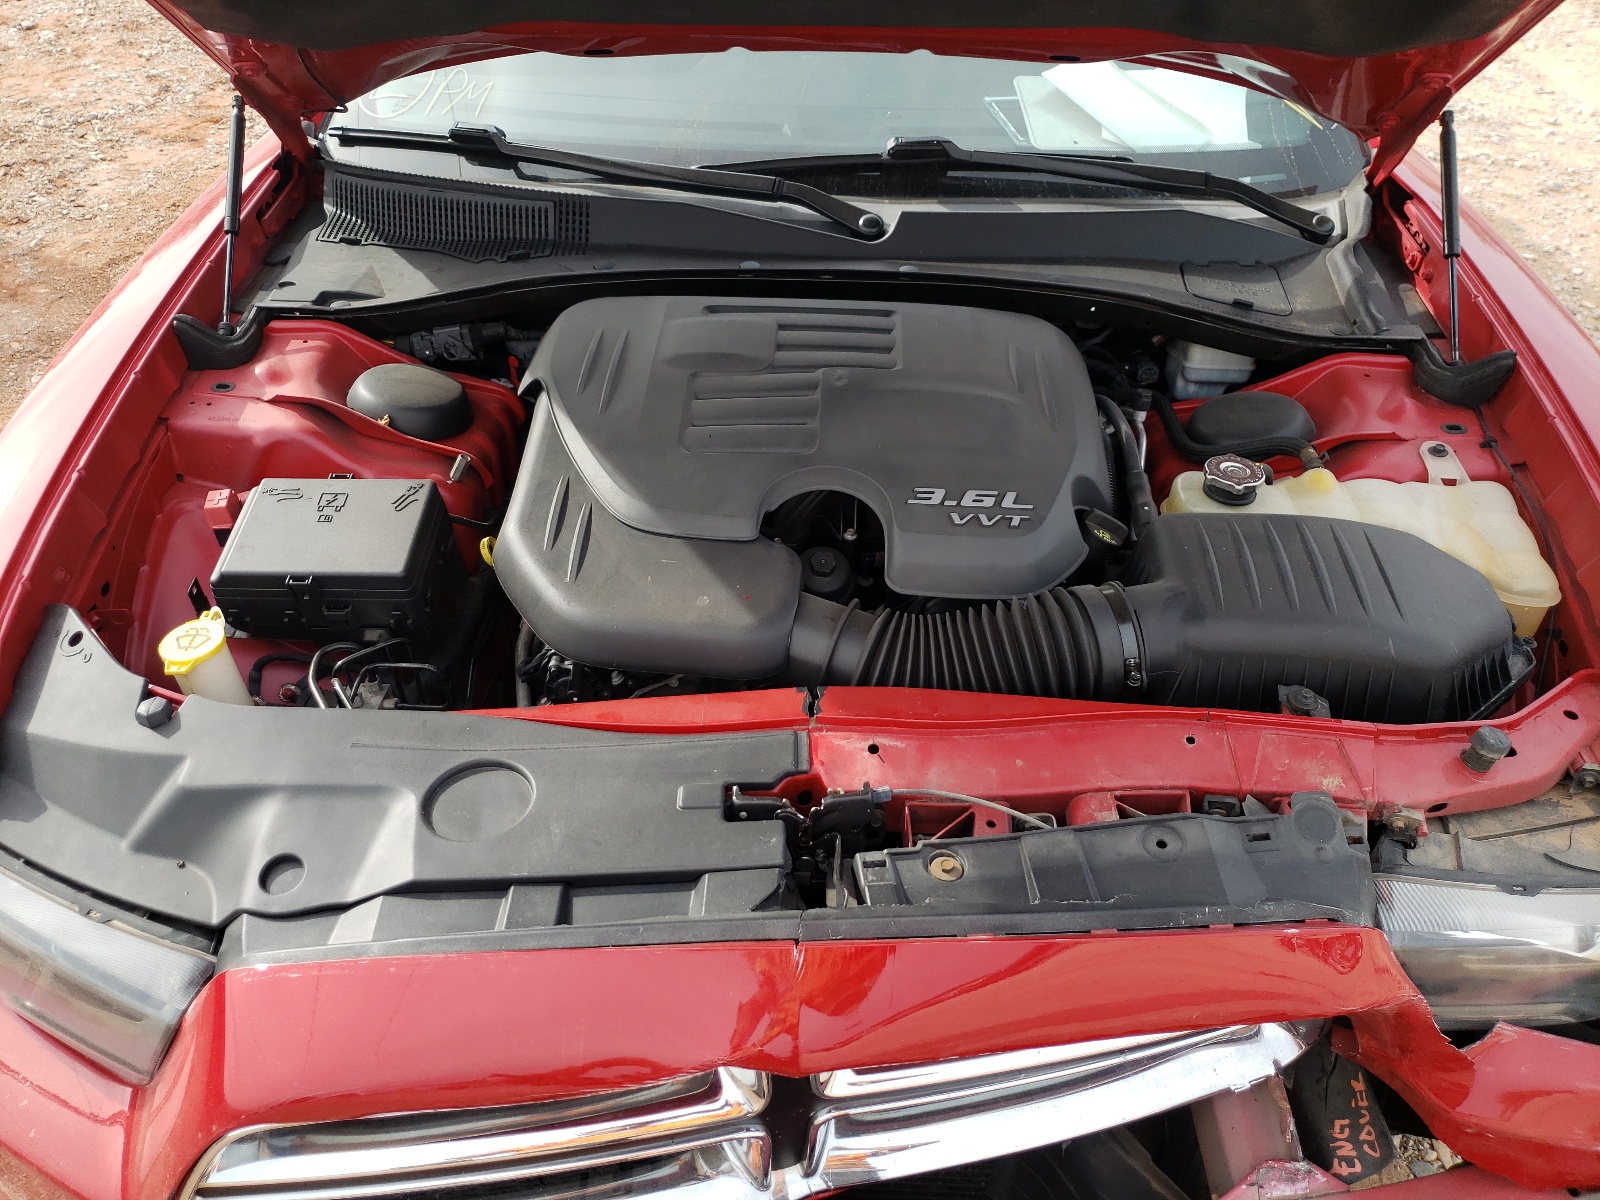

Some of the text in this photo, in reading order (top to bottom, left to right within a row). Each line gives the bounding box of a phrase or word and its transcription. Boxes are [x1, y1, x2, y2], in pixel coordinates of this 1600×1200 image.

[907, 487, 1034, 510] 3.6L
[950, 512, 1030, 528] VVT
[1330, 1119, 1362, 1176] ENG
